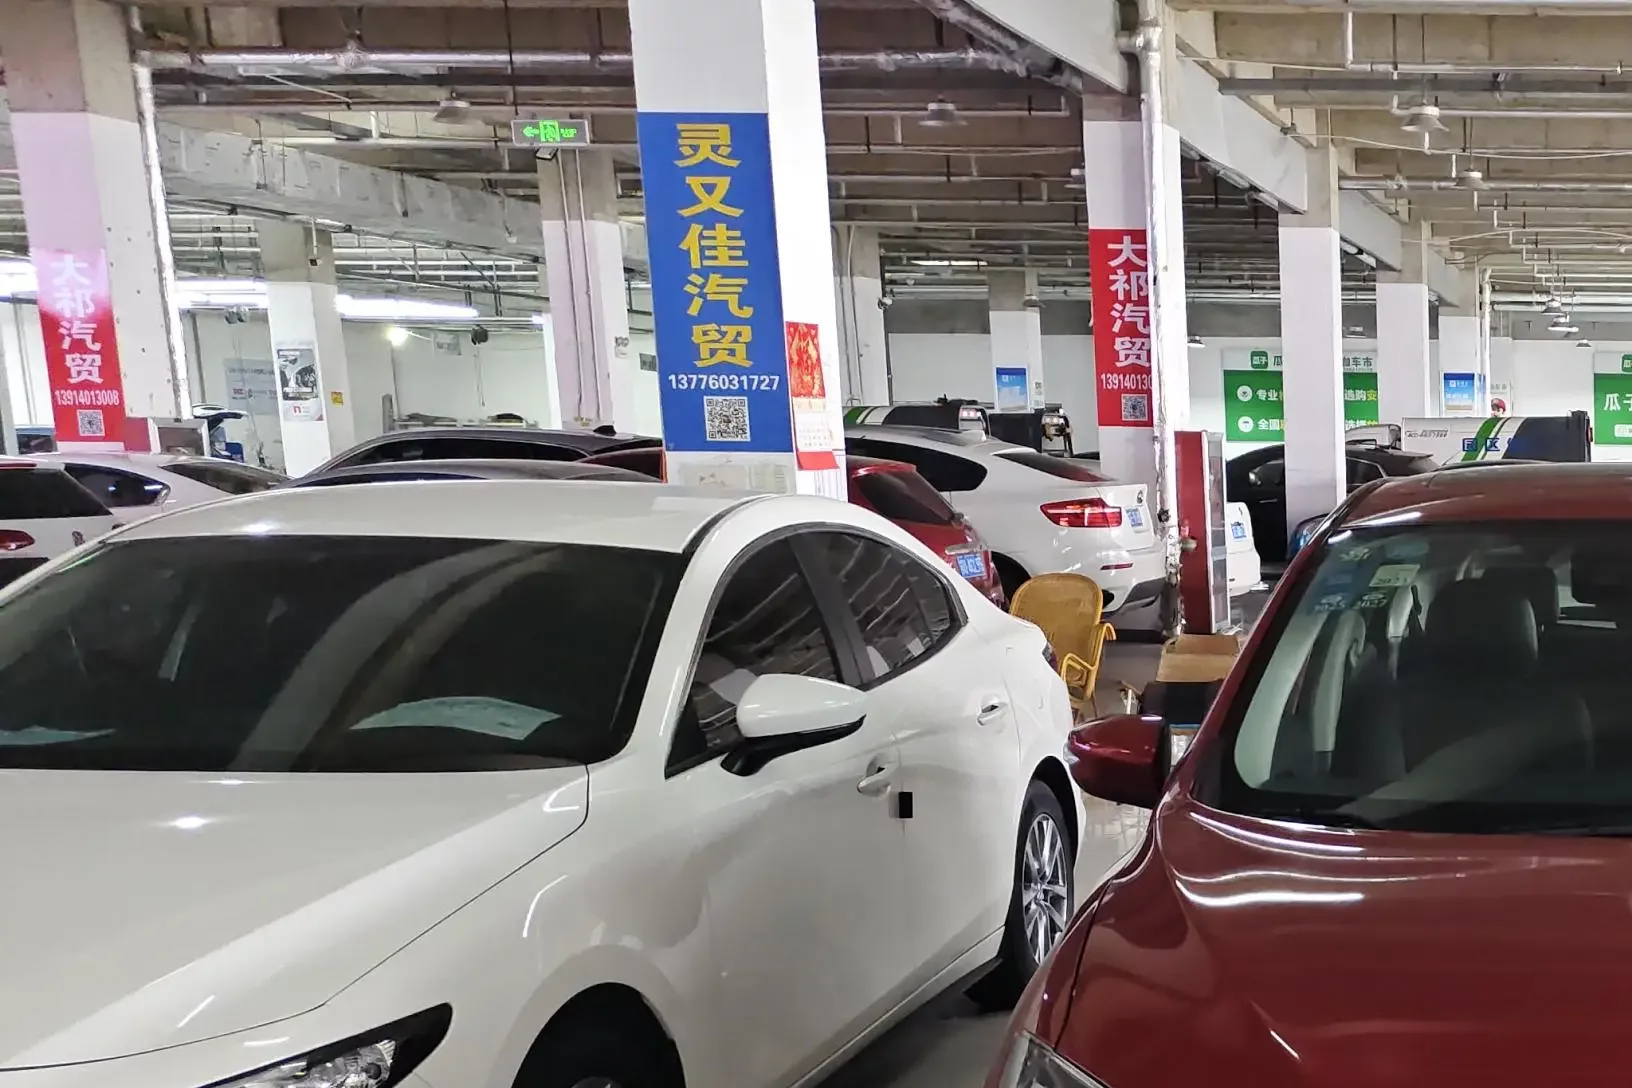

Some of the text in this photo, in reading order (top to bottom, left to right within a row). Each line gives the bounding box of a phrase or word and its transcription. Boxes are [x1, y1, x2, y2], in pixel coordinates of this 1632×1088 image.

[673, 123, 753, 367] 灵又佳汽贸
[1107, 235, 1150, 368] 大祁汽贸
[51, 253, 104, 384] 大祁汽贸
[668, 374, 780, 391] 13776031727
[55, 388, 120, 406] 13914013008
